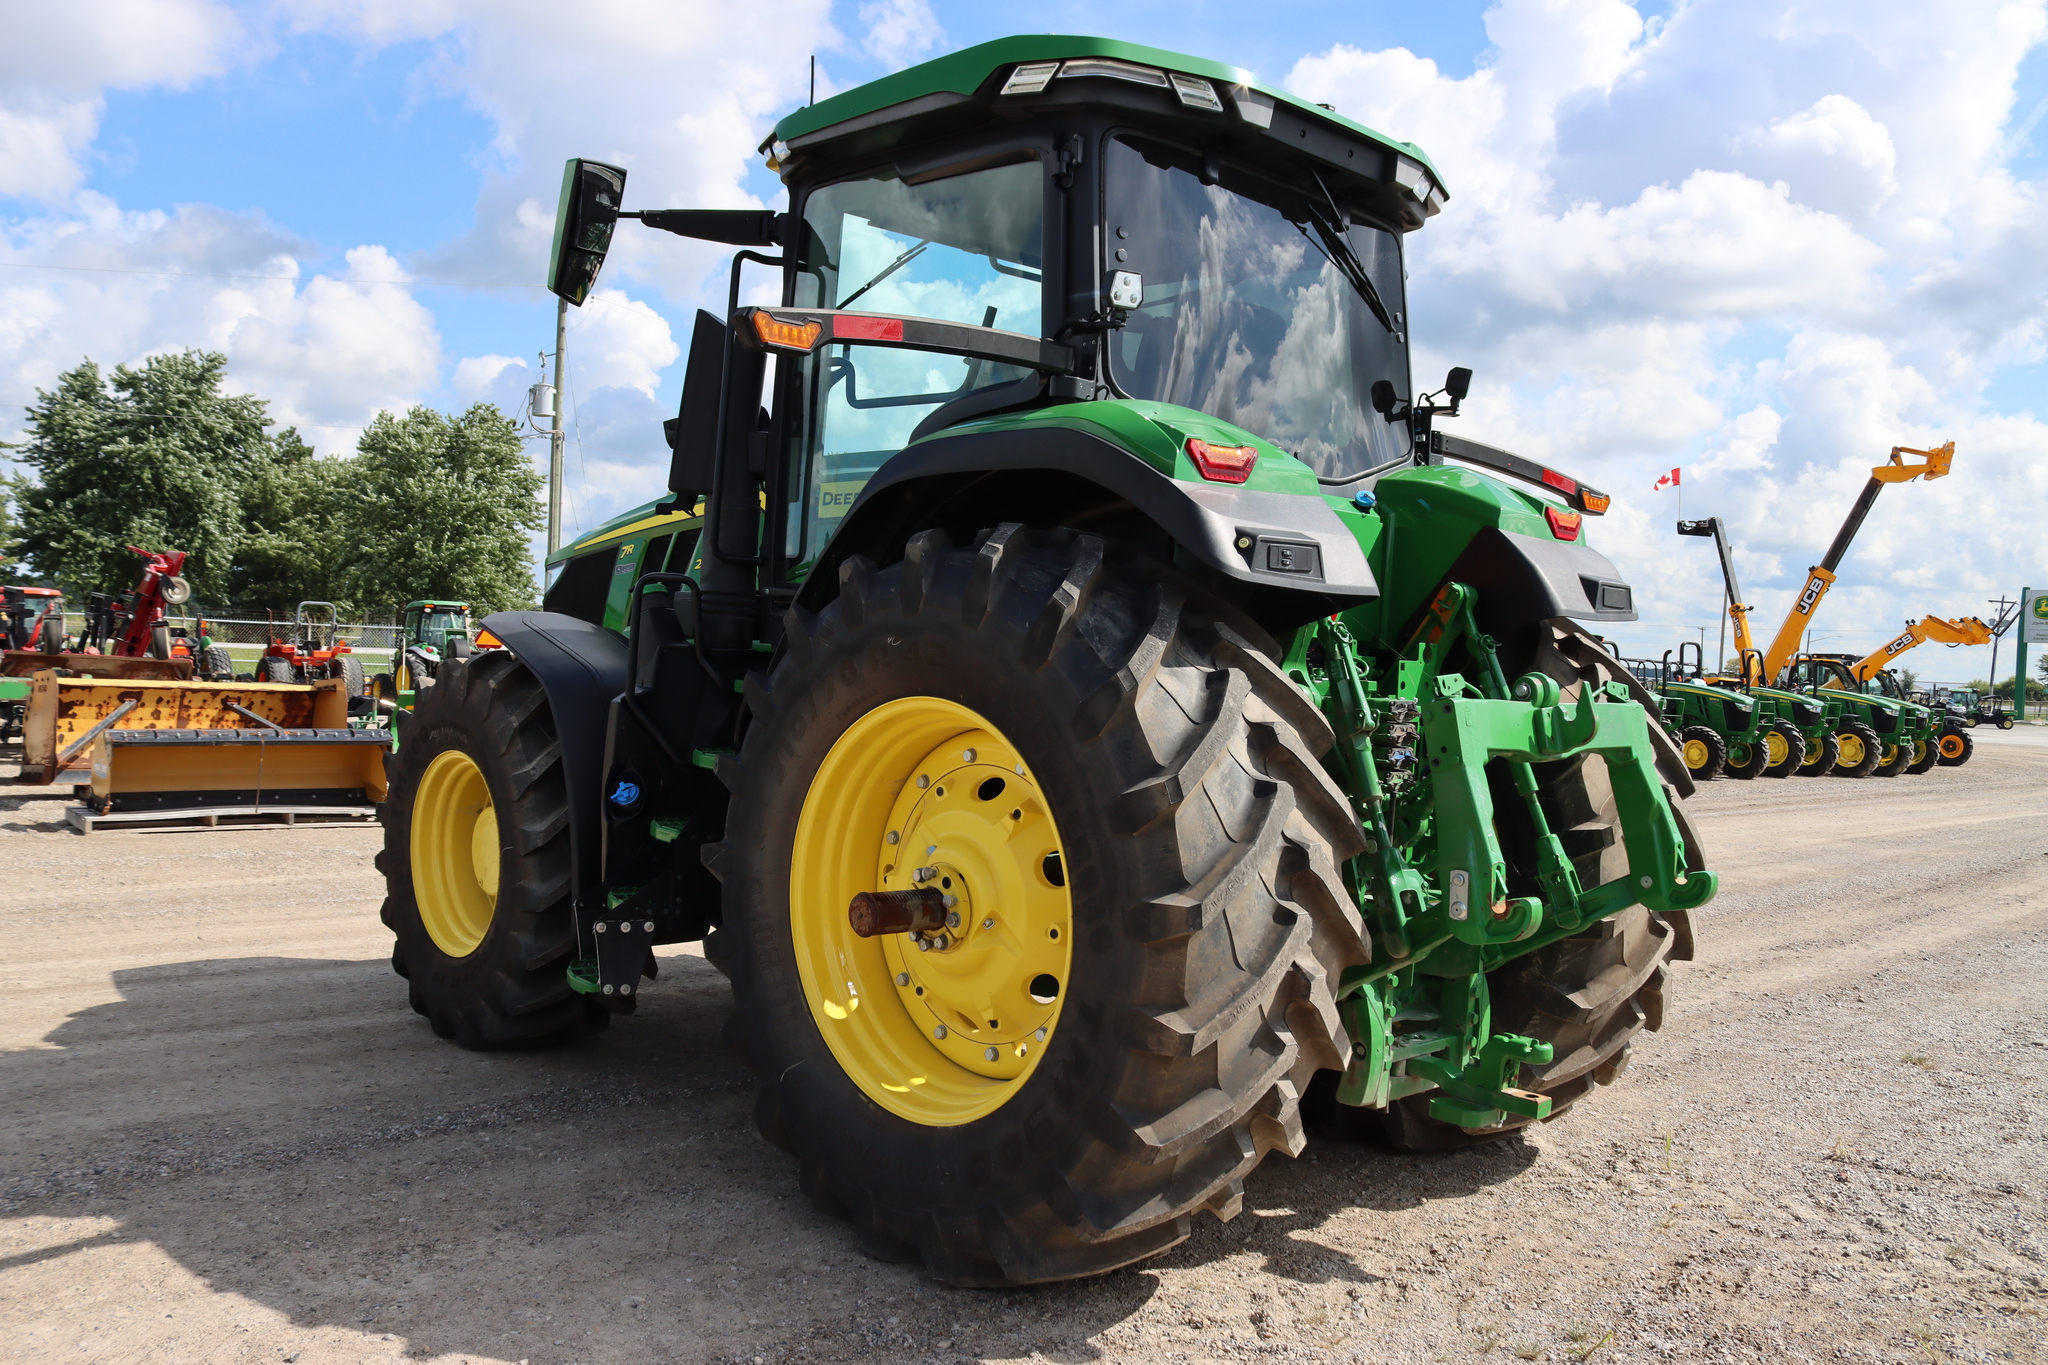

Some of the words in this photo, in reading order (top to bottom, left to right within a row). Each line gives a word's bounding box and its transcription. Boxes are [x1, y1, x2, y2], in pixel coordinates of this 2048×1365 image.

[619, 544, 635, 559] 7R
[1800, 577, 1825, 614] JCB
[1733, 617, 1742, 638] JCB
[903, 640, 948, 667] 42
[1887, 634, 1914, 655] JCB
